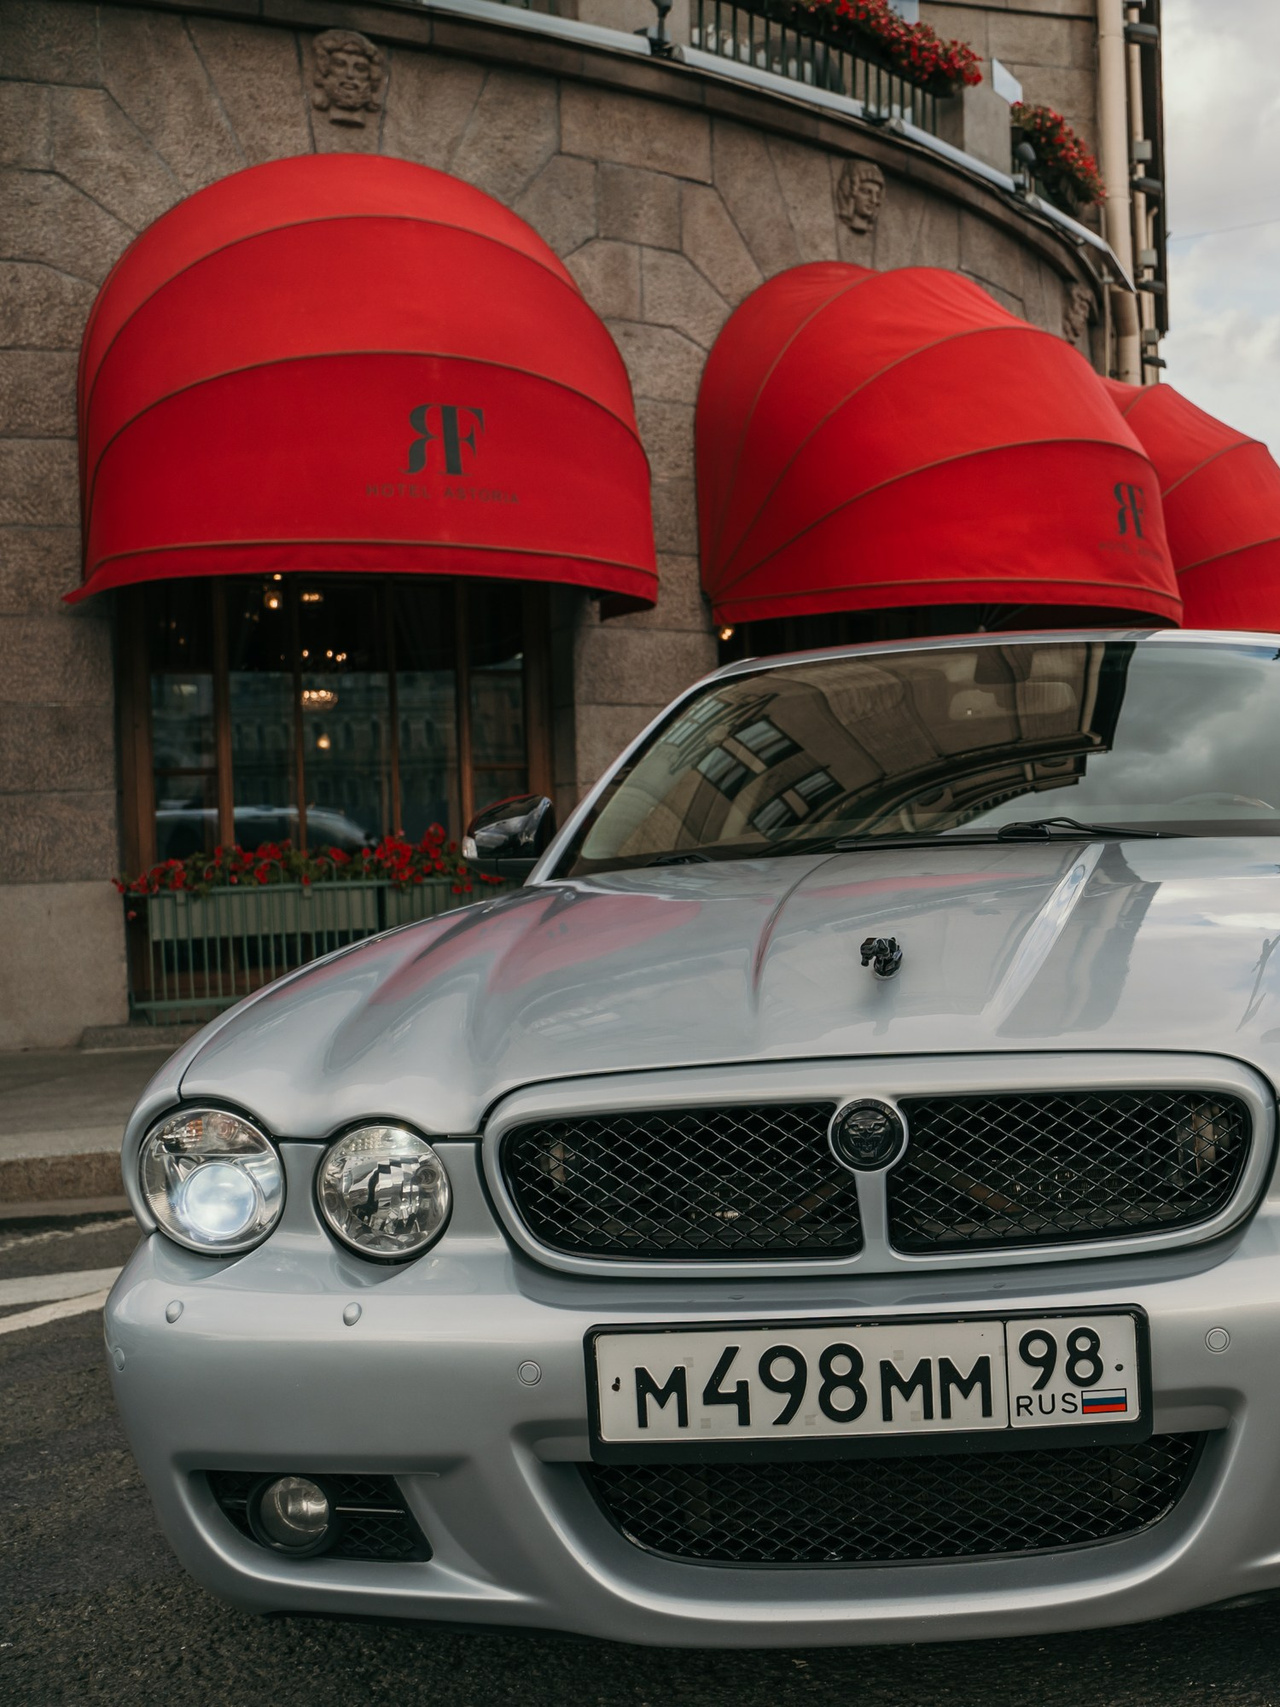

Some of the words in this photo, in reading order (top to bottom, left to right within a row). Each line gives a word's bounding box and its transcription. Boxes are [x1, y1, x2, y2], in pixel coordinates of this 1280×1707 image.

[365, 483, 430, 499] HOTEL
[444, 487, 519, 504] ASTORIA
[1019, 1327, 1103, 1390] 98
[1017, 1393, 1078, 1417] RUS
